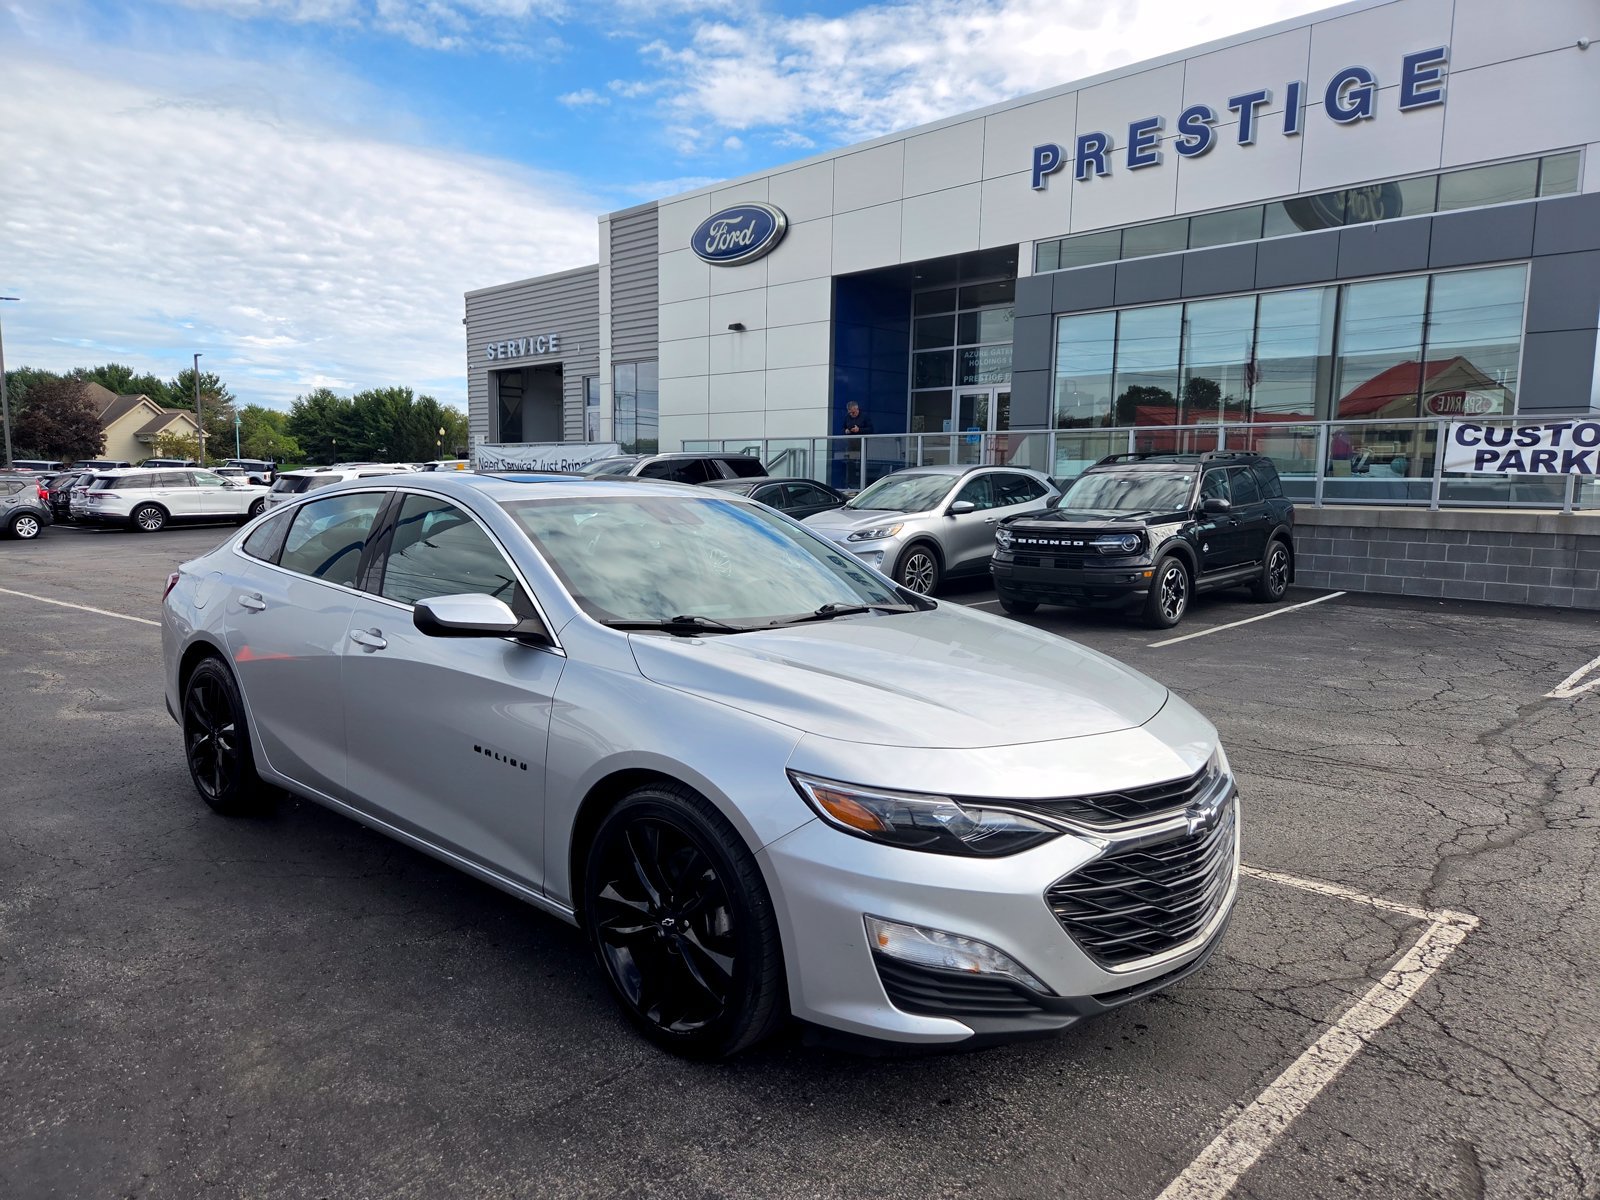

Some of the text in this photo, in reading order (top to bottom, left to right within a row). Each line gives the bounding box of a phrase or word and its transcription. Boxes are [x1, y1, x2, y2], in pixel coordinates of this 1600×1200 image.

[1031, 45, 1449, 191] PRESTIGE
[705, 216, 756, 253] Ford
[487, 333, 559, 360] SERVICE
[969, 357, 1007, 367] HOLDINGS
[963, 373, 1004, 383] PRESTIGE
[1455, 423, 1600, 447] CUSTO
[1474, 449, 1600, 474] PARK
[1018, 538, 1084, 546] BRONCO
[474, 744, 527, 771] MALIBU
